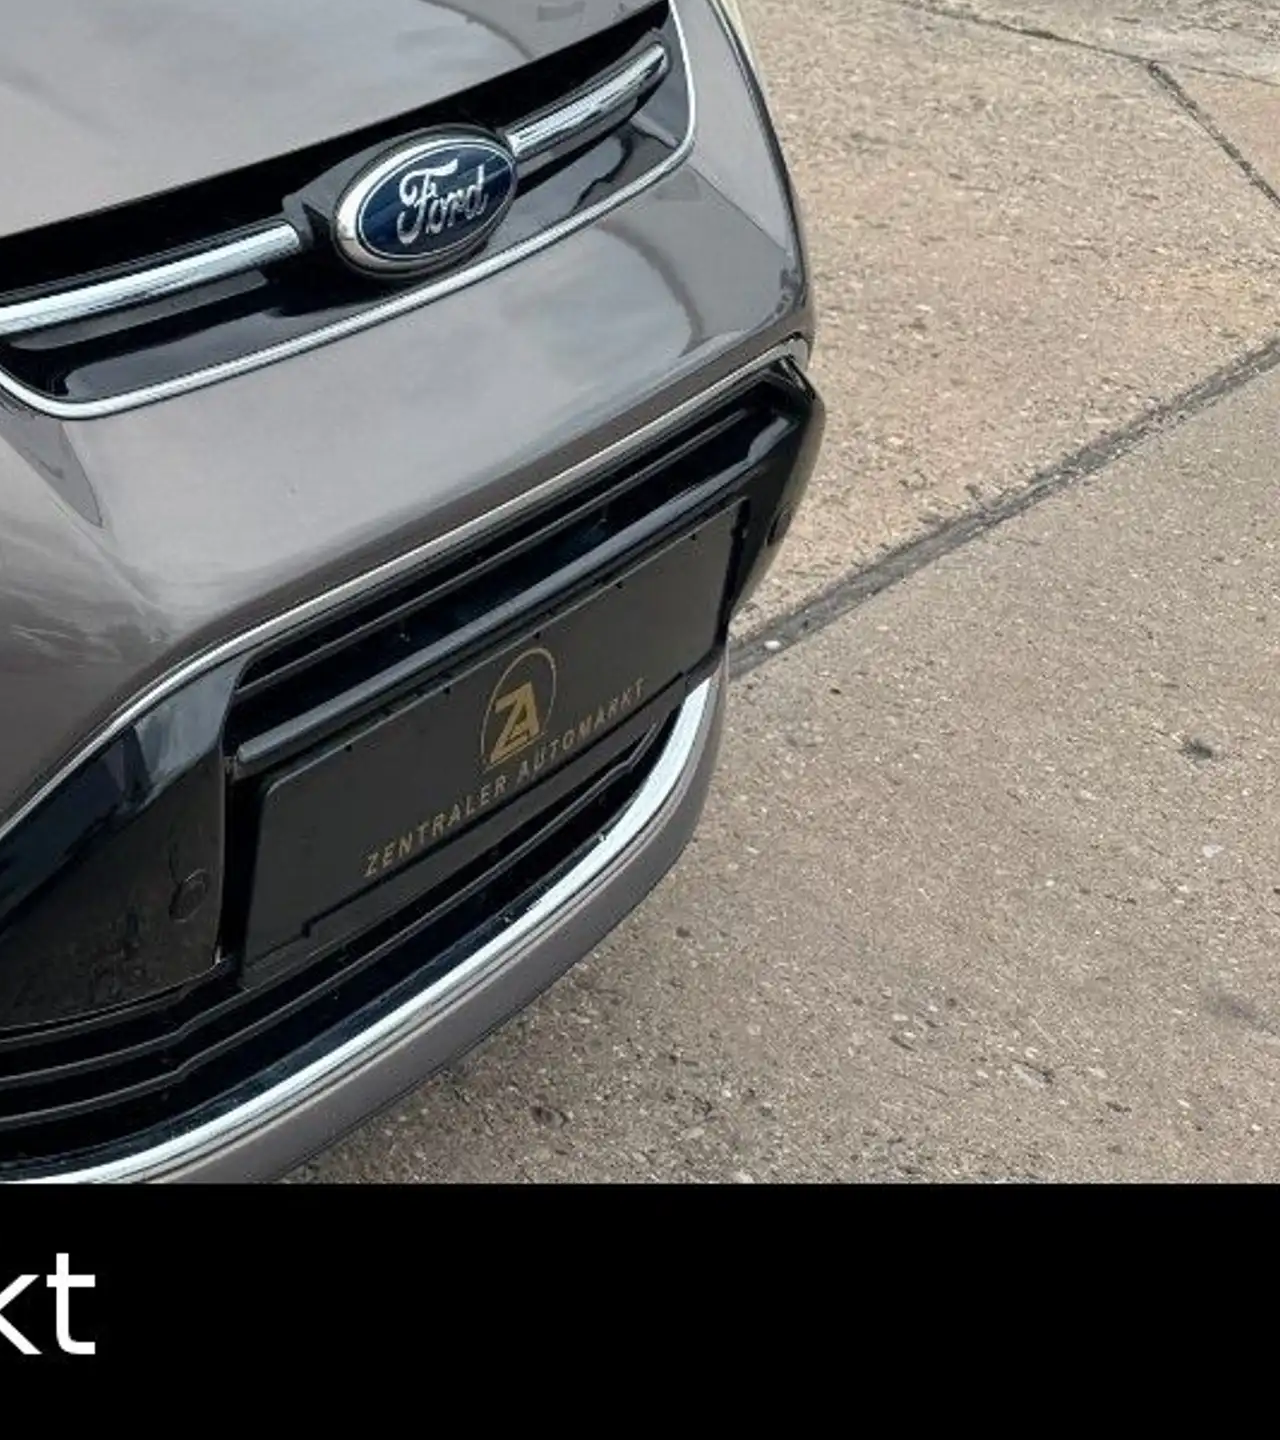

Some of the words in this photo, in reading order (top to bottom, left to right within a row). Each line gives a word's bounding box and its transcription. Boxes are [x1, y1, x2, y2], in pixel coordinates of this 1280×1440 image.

[396, 158, 489, 245] Ford
[363, 773, 508, 878] ZENTRALER
[516, 677, 644, 783] AUTOMARKT
